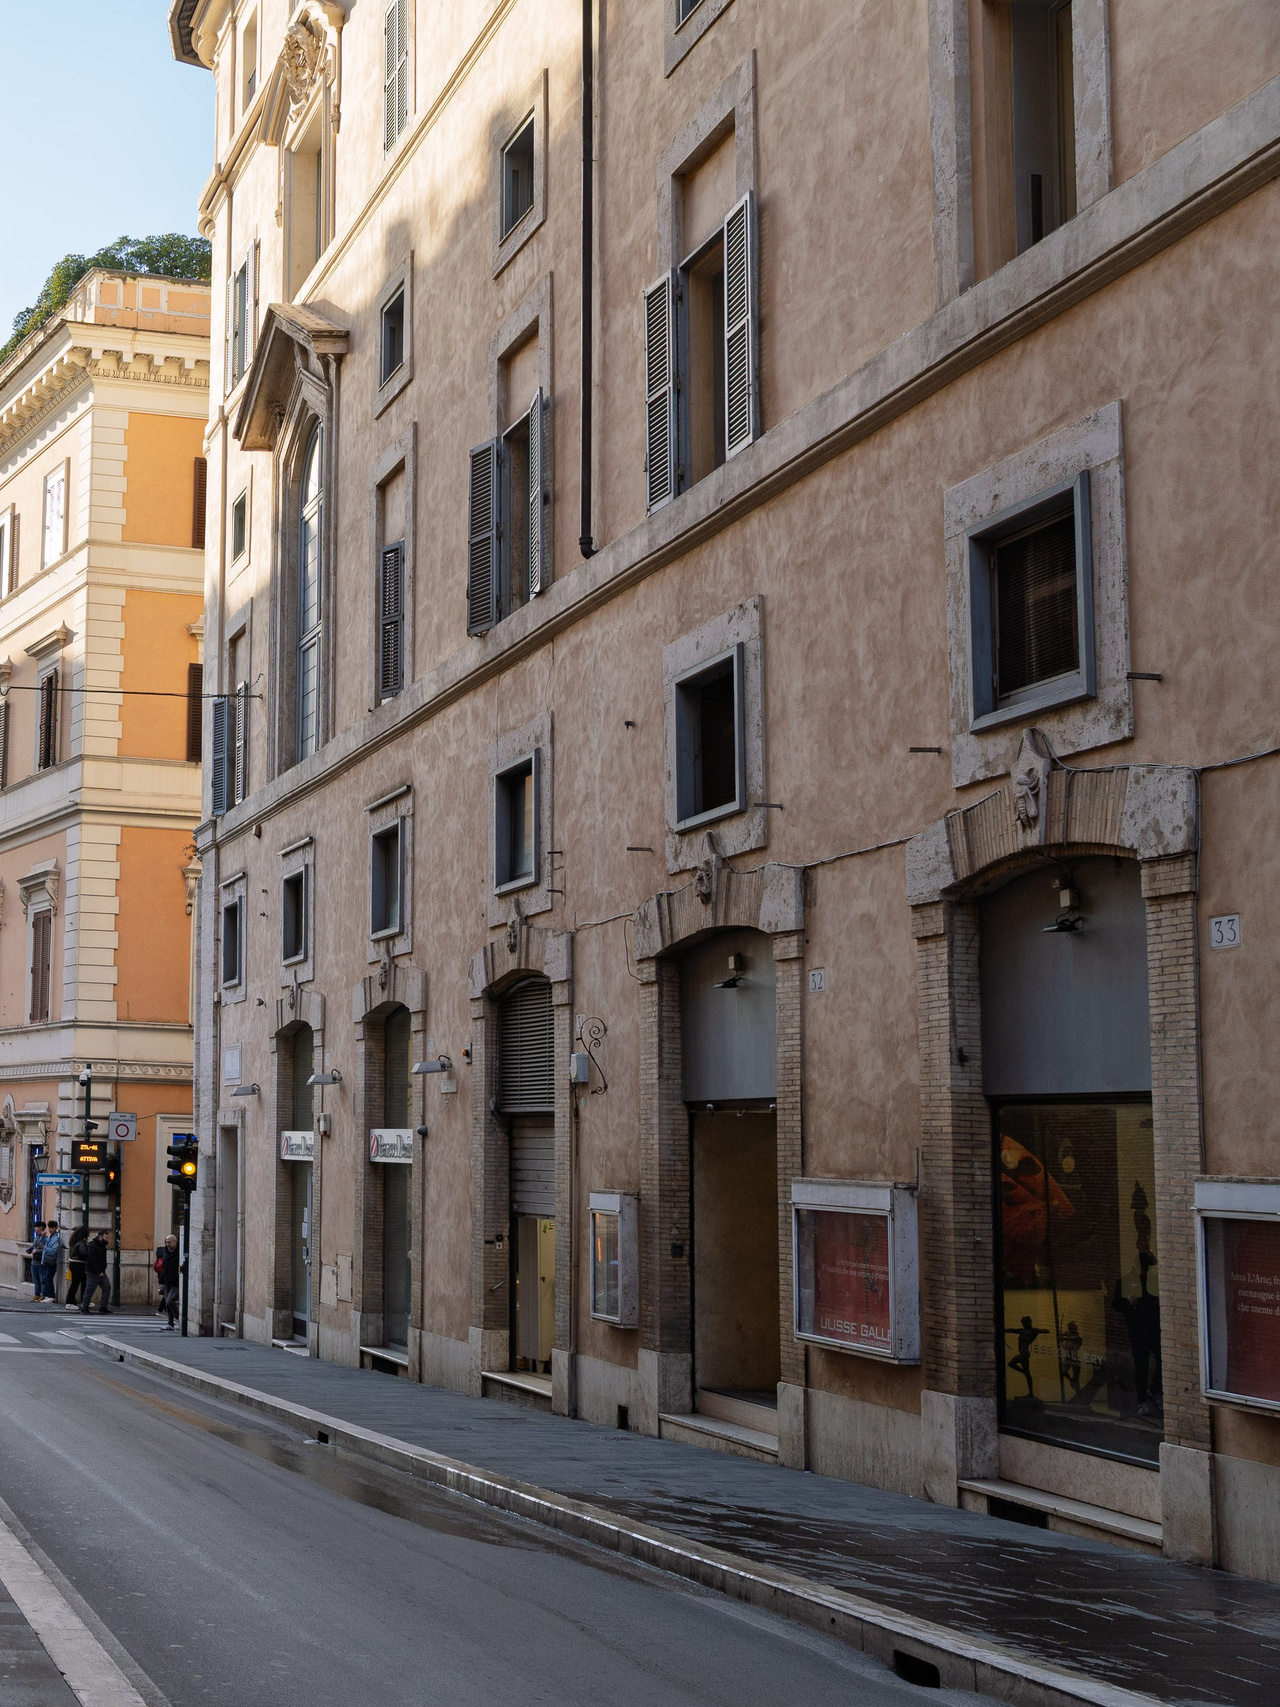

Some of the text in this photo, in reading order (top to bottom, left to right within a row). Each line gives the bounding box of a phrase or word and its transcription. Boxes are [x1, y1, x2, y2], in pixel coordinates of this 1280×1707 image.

[1214, 919, 1236, 943] 33
[811, 973, 823, 990] 32
[1238, 1289, 1275, 1301] menzogne
[1237, 1302, 1249, 1312] che
[1251, 1305, 1273, 1315] mente
[820, 1317, 857, 1335] ULISSE
